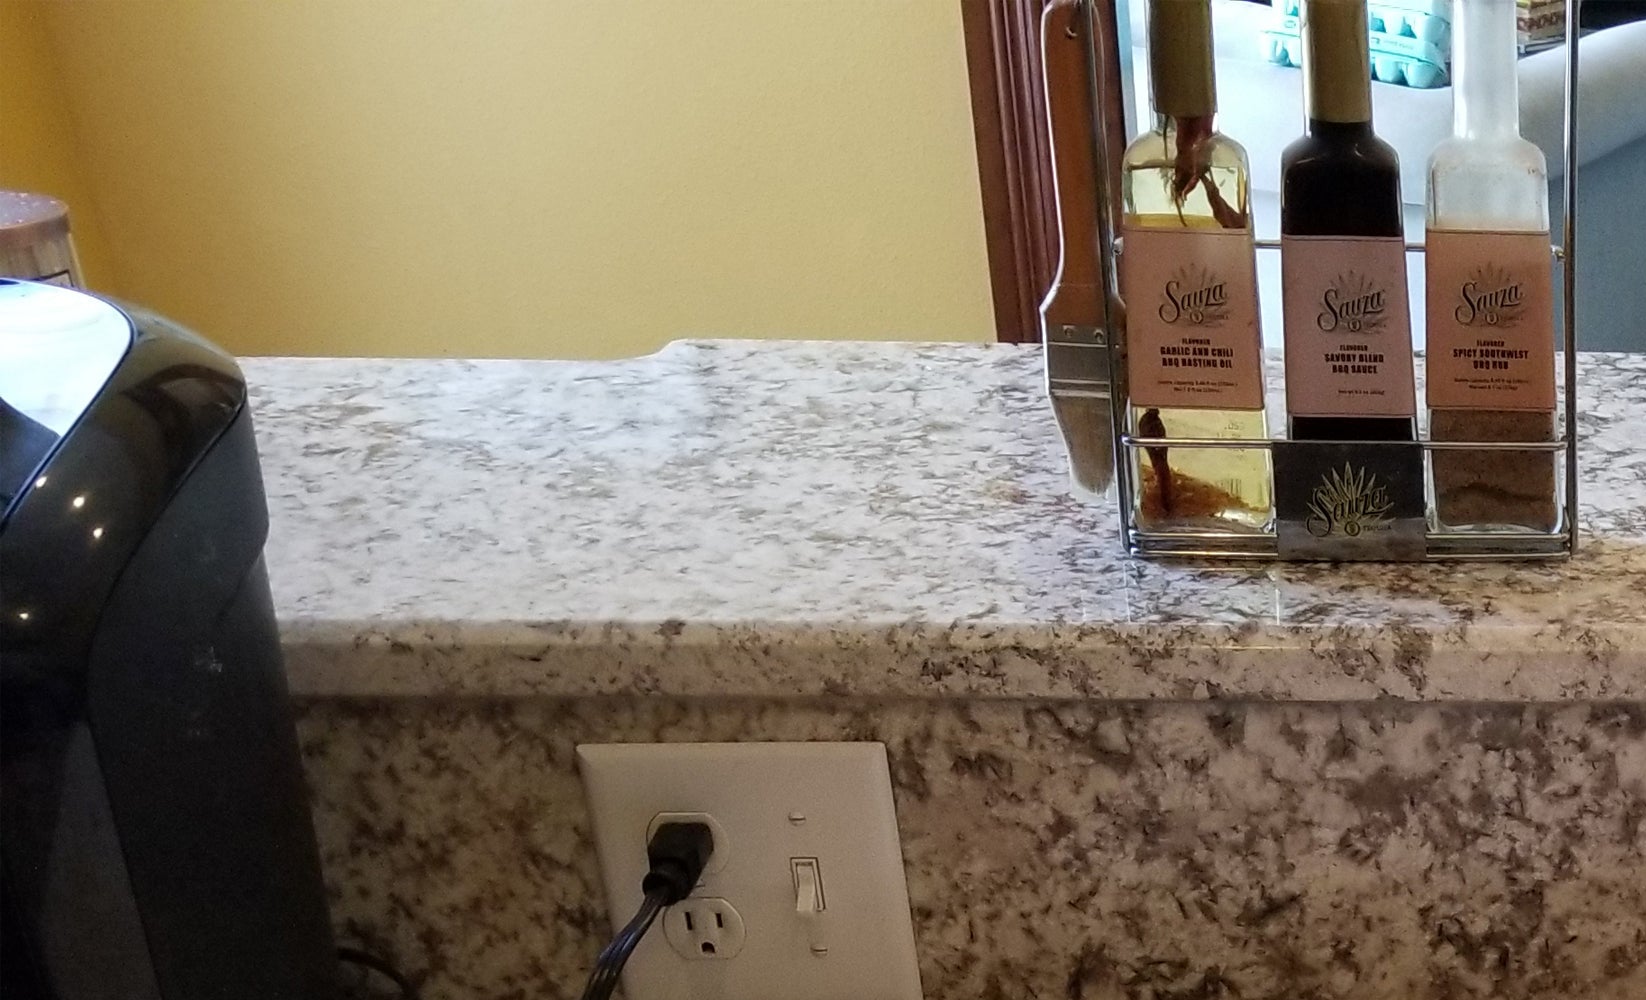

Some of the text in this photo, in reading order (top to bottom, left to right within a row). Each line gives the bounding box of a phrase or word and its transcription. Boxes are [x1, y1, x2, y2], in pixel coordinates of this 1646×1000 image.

[1158, 280, 1228, 324] Sauza
[1454, 281, 1523, 326] Sauza
[1317, 288, 1385, 332] Sauza
[1160, 346, 1234, 357] GARLIC AND CHILI
[1453, 348, 1529, 359] SPICY SOUTHWEST
[1162, 357, 1233, 369] BBQ BASTING OIL
[1324, 353, 1384, 363] SAVORY BLEND
[1332, 364, 1378, 374] BBQ SAUCE
[1473, 360, 1509, 370] BBQ RUB
[1306, 485, 1394, 537] Sauza
